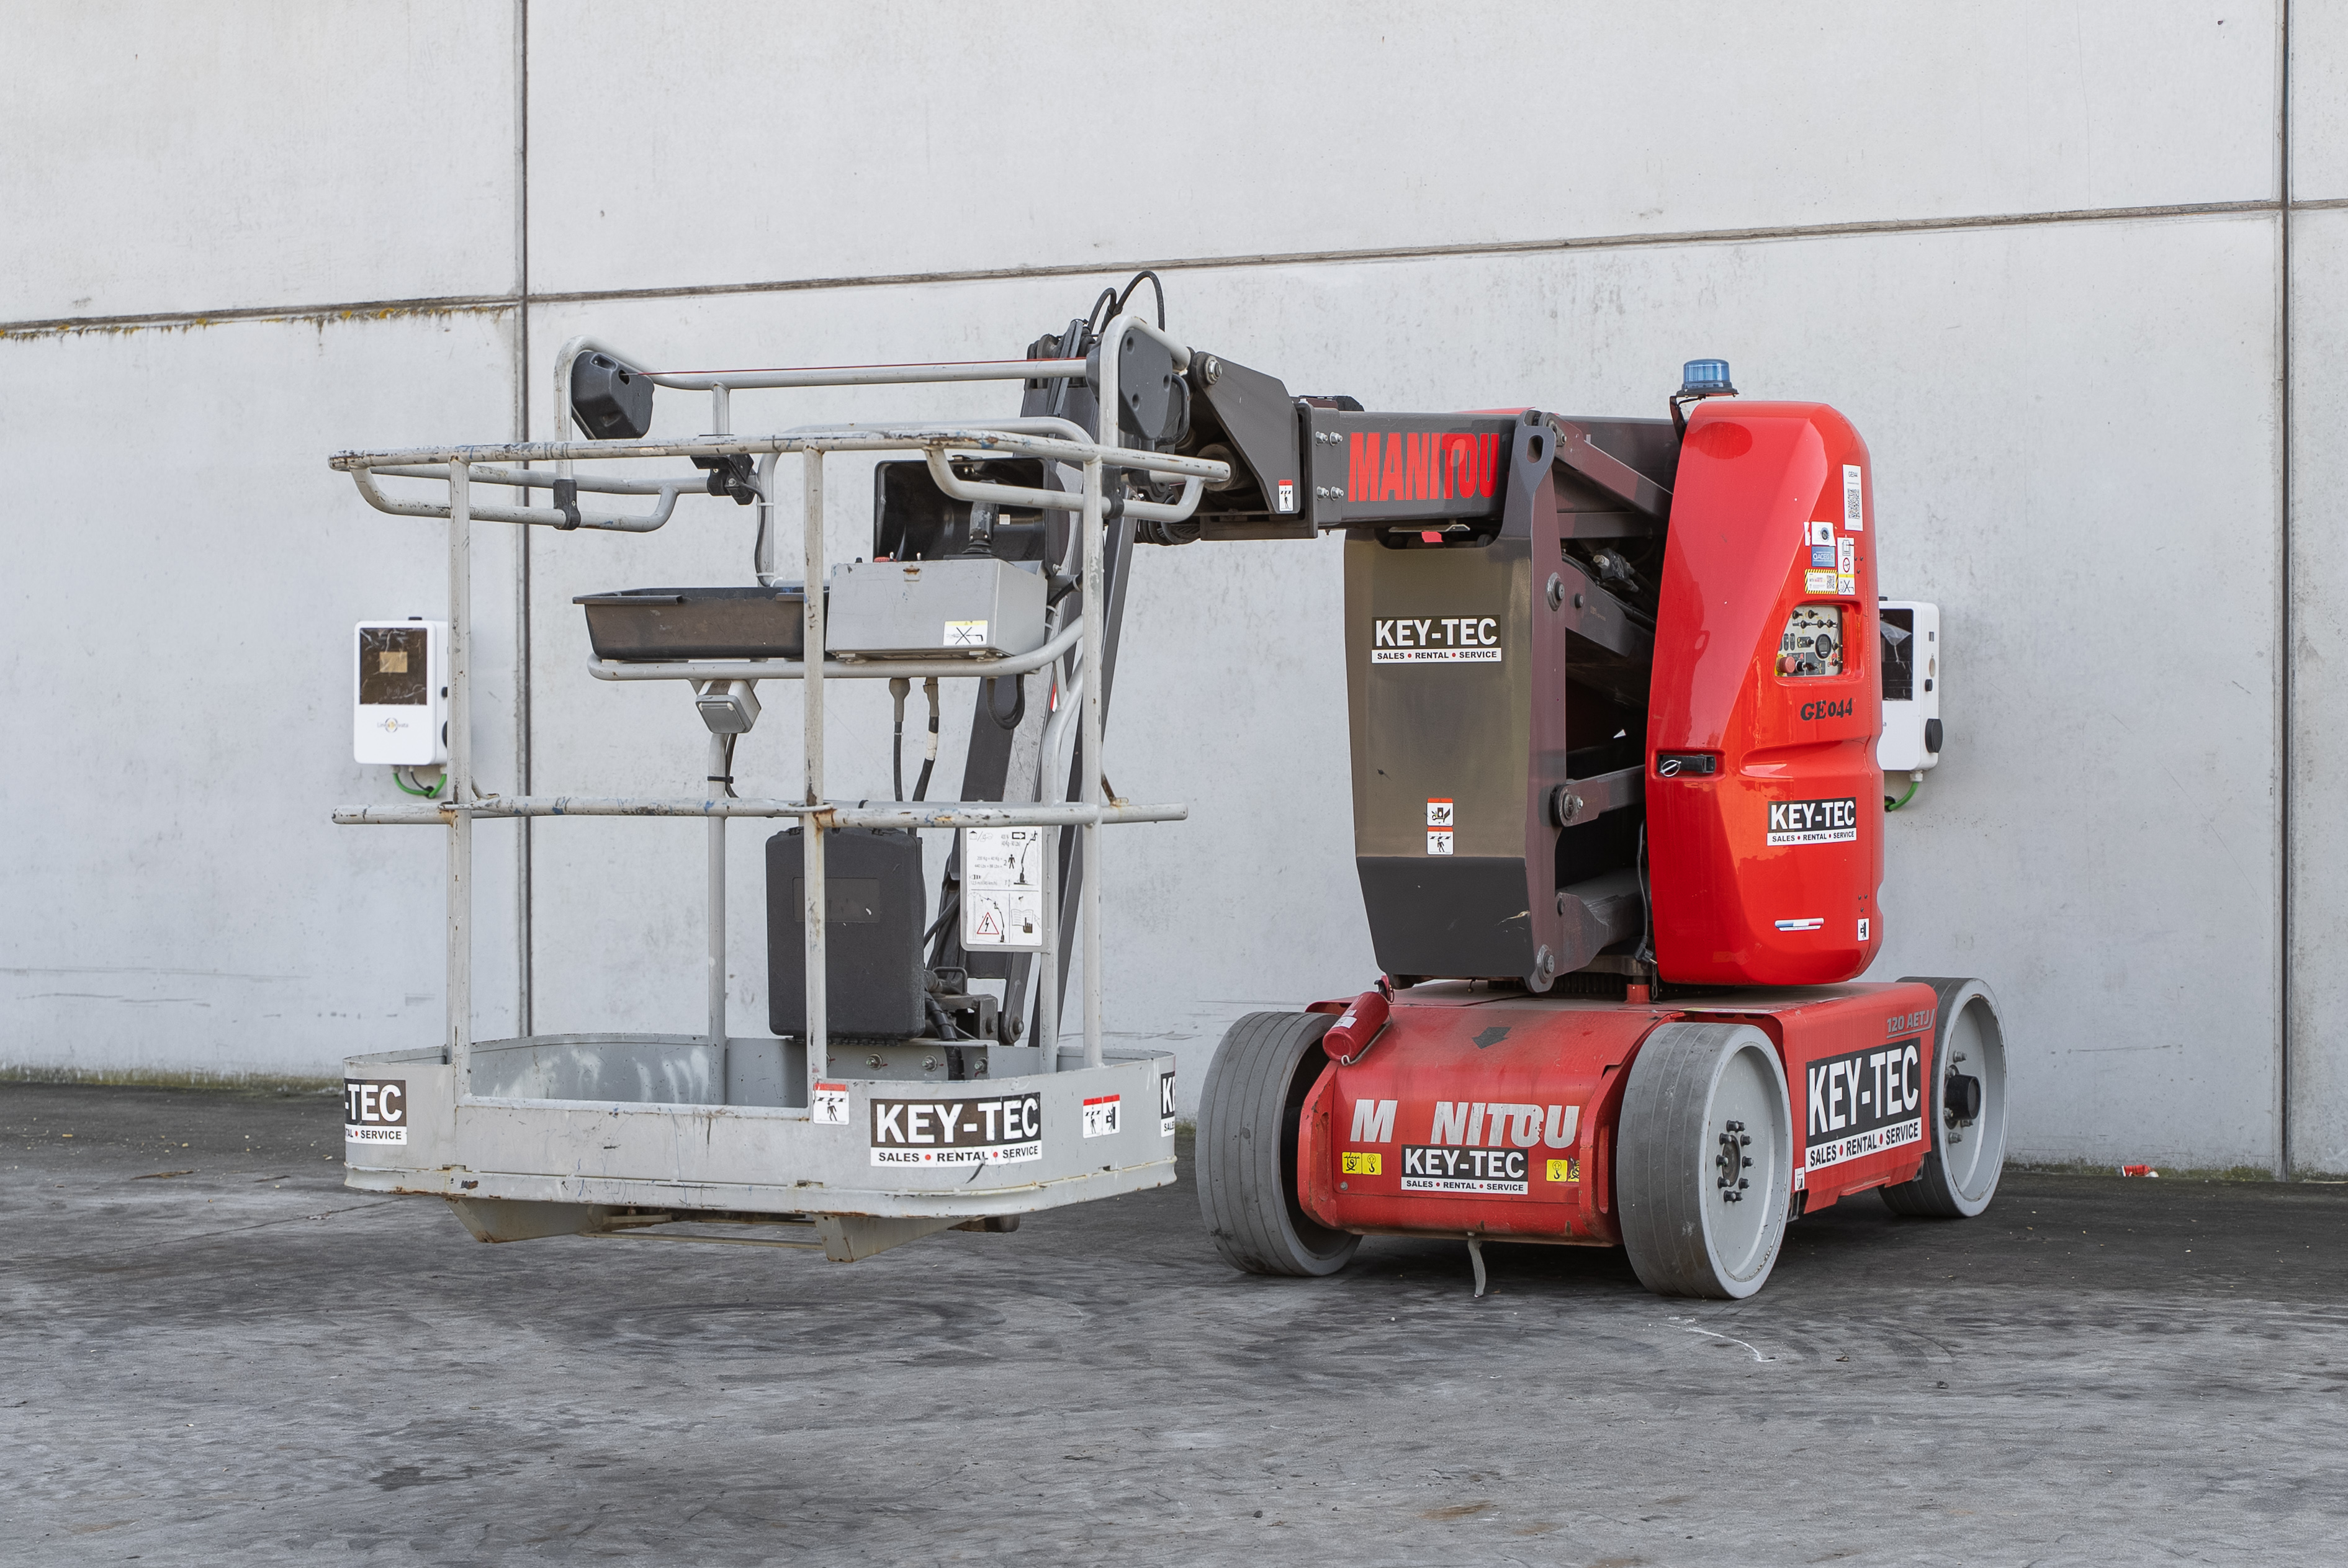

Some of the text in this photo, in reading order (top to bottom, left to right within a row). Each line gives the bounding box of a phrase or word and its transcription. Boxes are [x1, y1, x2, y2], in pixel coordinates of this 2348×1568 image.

[1348, 432, 1499, 502] MANITOU
[1375, 618, 1498, 647] KEY-TEC
[1377, 651, 1497, 660] SALES RENTAL SERVICE
[1800, 698, 1853, 720] GE044
[1770, 800, 1855, 830] KEY-TEC
[1802, 833, 1827, 841] RENTAL
[1833, 831, 1855, 839] SERVICE
[1887, 1010, 1930, 1033] 120 AETJ
[344, 1083, 402, 1122] -TEC
[1809, 1044, 1919, 1137] KEY-TEC
[876, 1097, 1039, 1143] KEY-TEC
[360, 1130, 402, 1140] SERVICE
[1809, 1122, 1918, 1167] SALES RENTAL SERVICE
[878, 1145, 1038, 1162] SALES RENTAL SERVICE
[1405, 1148, 1525, 1178] KEY-TEC
[1406, 1180, 1524, 1192] SALES RENTAL SERVICE
